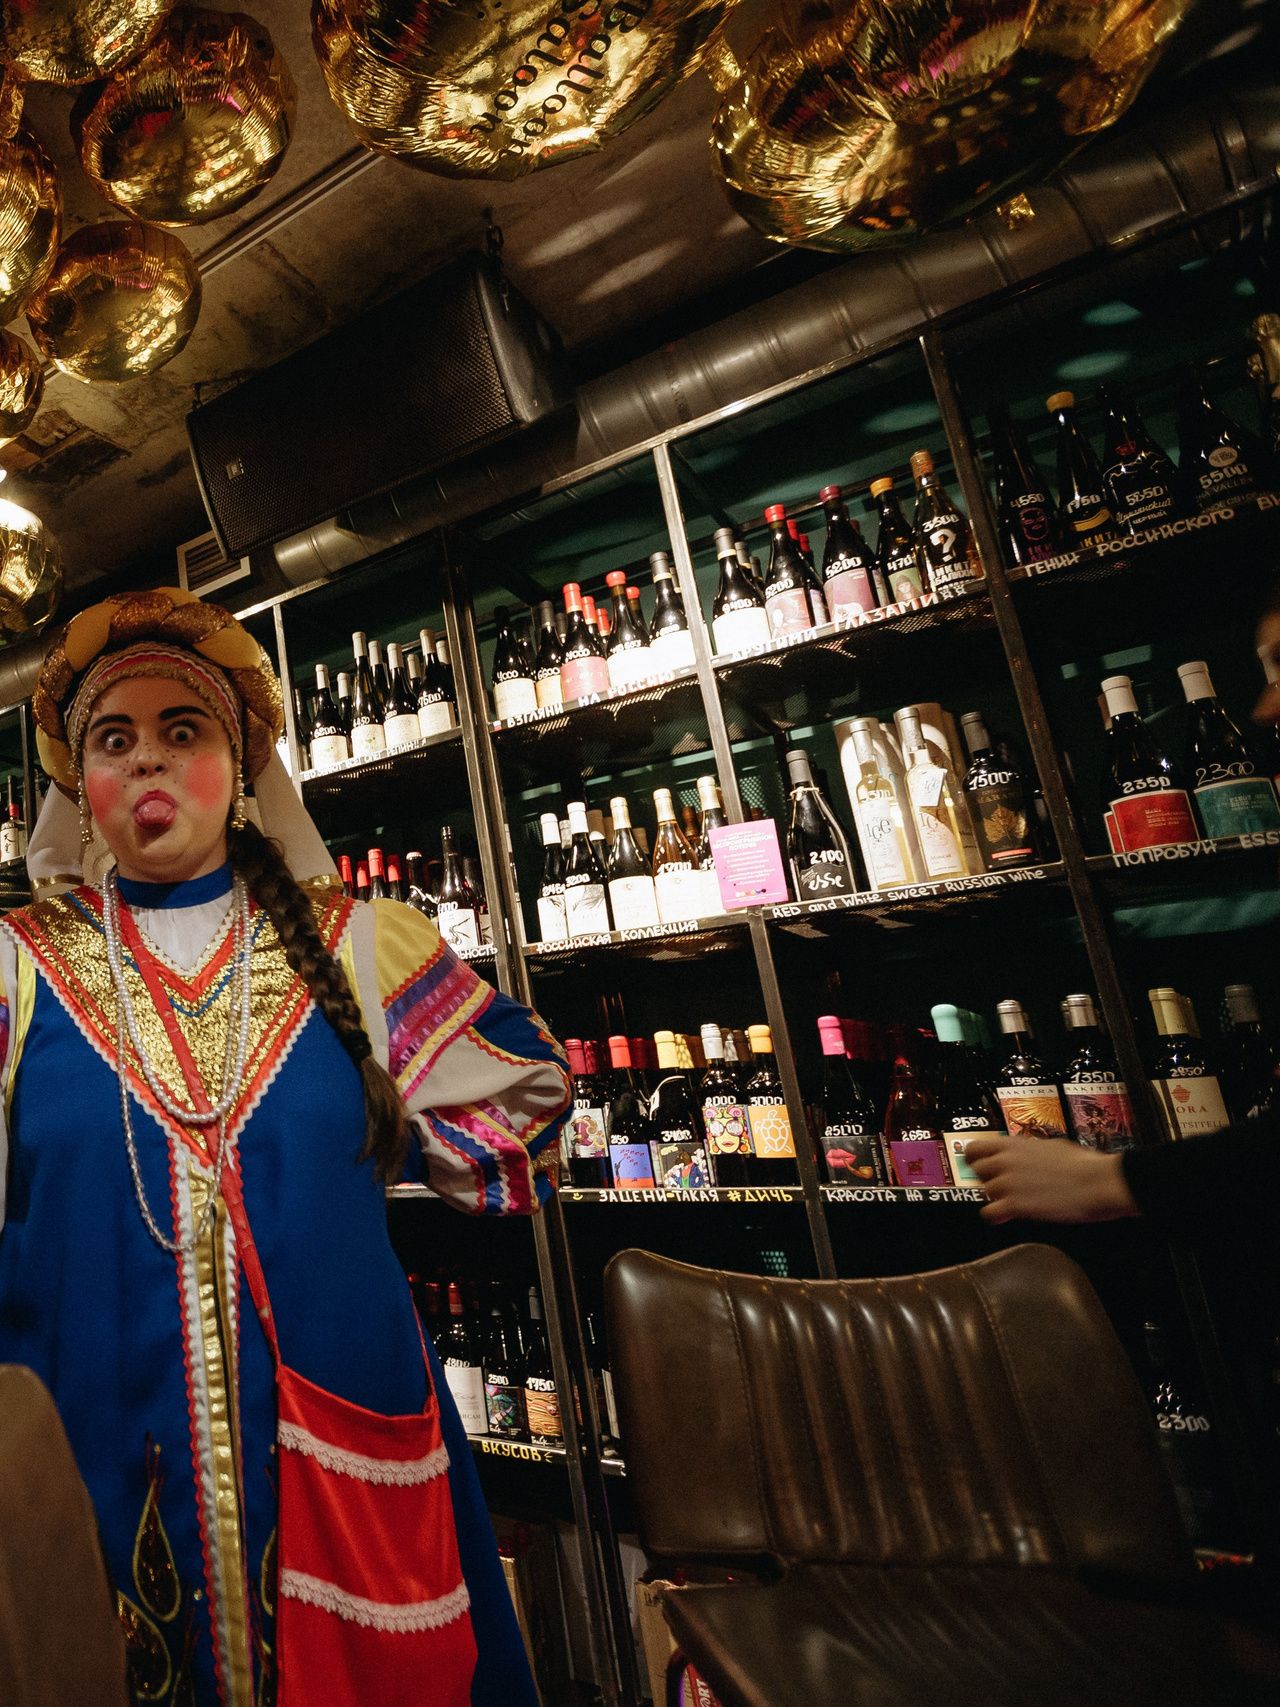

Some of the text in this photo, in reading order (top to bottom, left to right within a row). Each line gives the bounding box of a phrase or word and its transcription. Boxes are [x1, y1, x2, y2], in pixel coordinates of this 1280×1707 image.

[499, 0, 653, 158] Balloon
[1199, 462, 1249, 490] 5500
[887, 554, 914, 571] 470
[507, 702, 564, 728] ВЗГЛЯНИ
[578, 694, 601, 708] НА
[834, 593, 939, 632] ГЛАЗАМИ
[969, 771, 1011, 791] 1500
[1196, 761, 1255, 787] 2300
[1122, 775, 1171, 794] 2350
[1238, 832, 1280, 850] ESS
[810, 849, 844, 865] 2100
[808, 897, 837, 913] and
[621, 919, 700, 942] КОЛЛЕКЦИЯ
[826, 1188, 898, 1202] КРАСОТА
[905, 1188, 924, 1202] НА
[1156, 1412, 1211, 1432] 2300
[481, 1440, 542, 1463] ВКУСОВ
